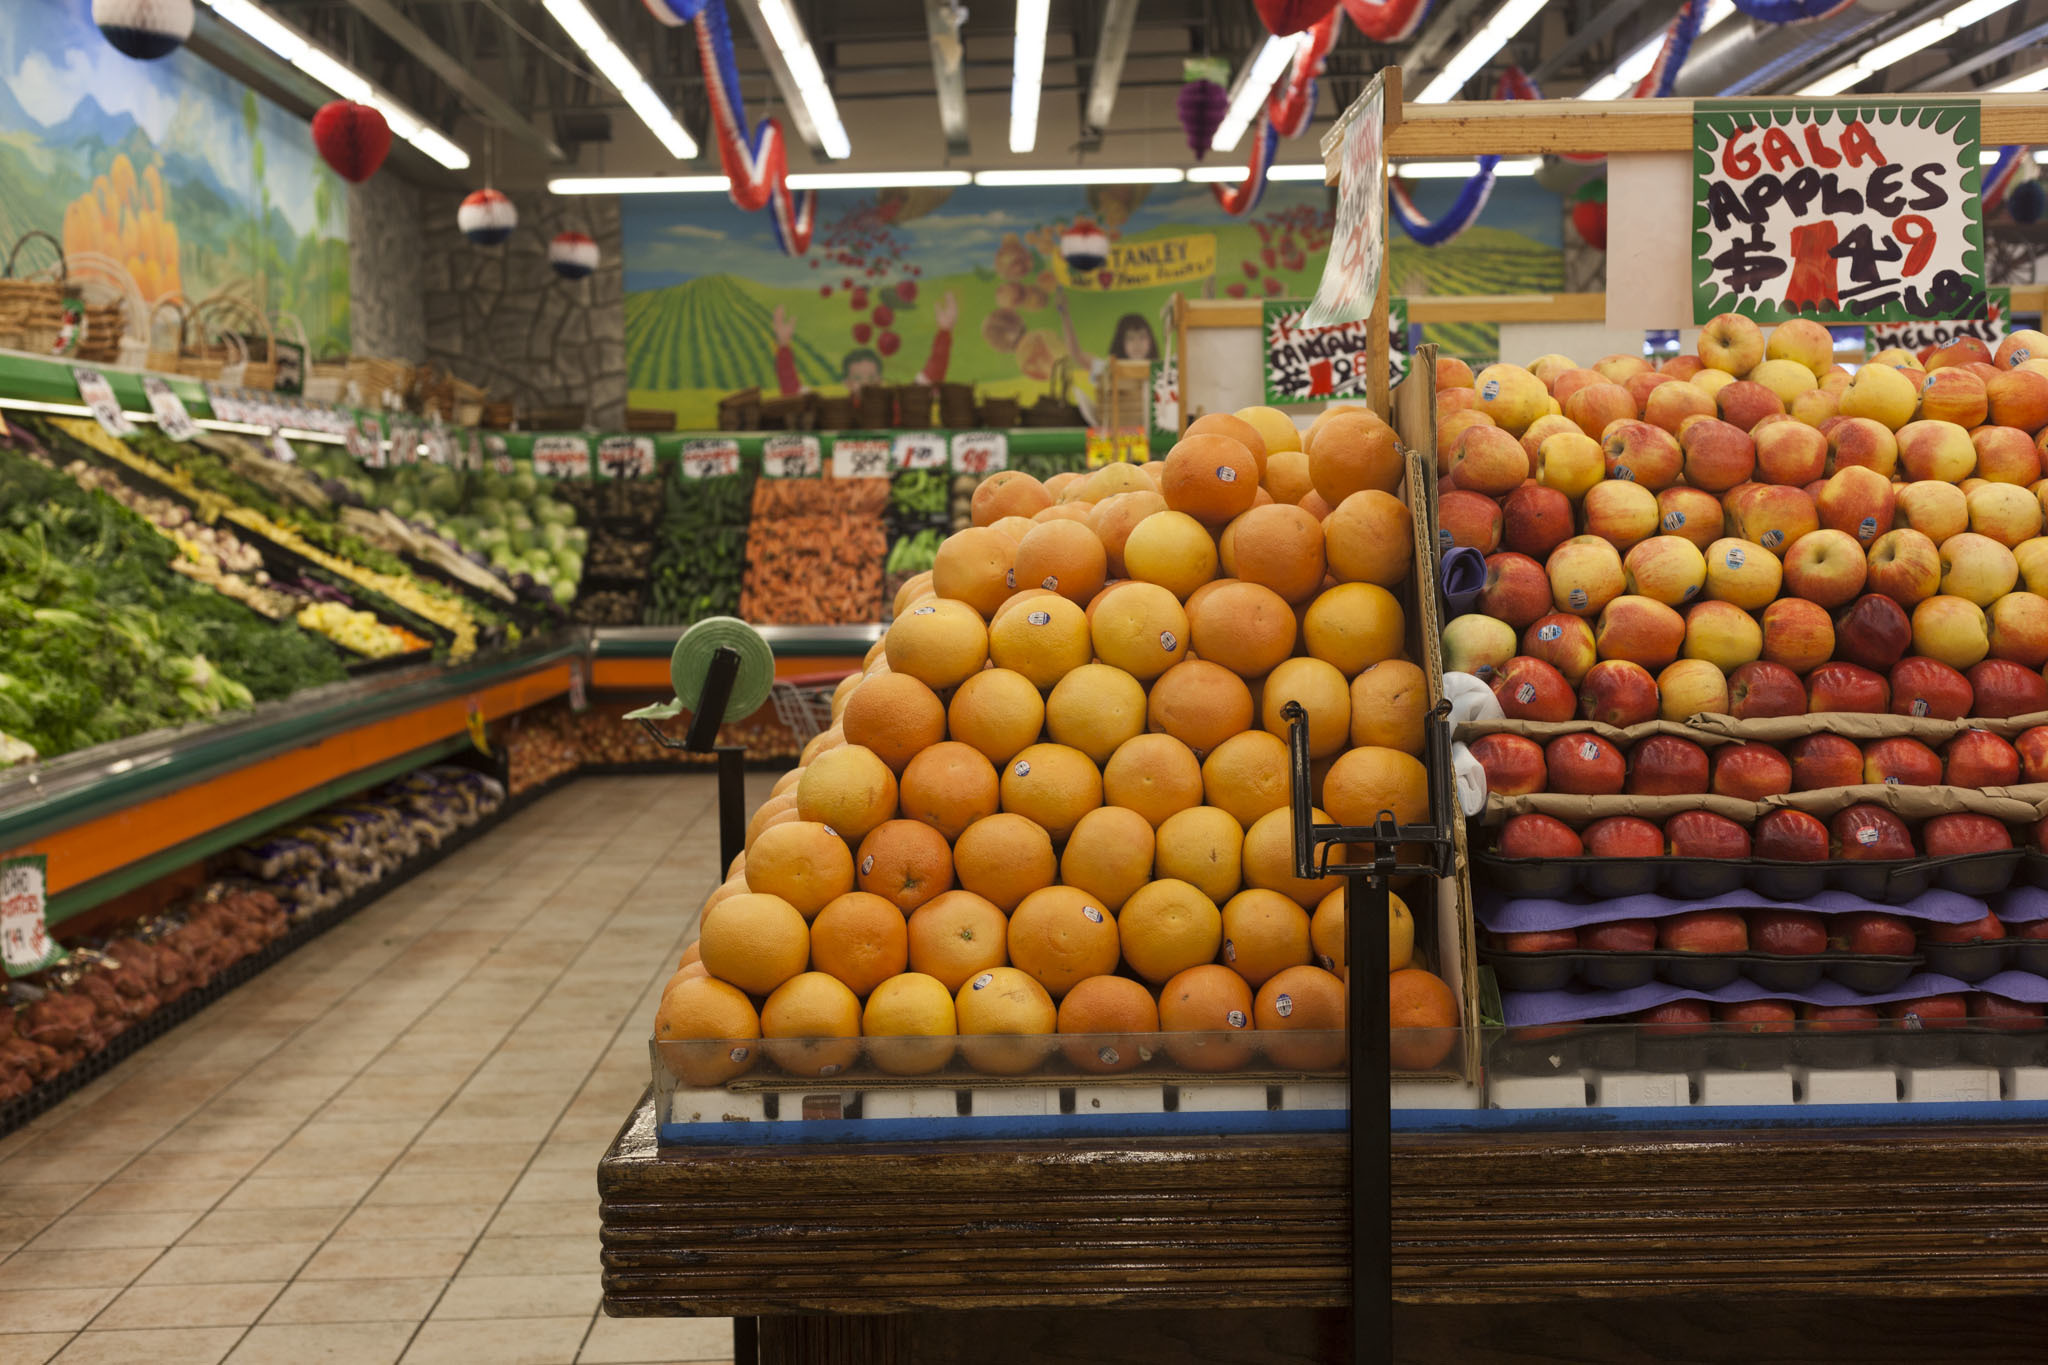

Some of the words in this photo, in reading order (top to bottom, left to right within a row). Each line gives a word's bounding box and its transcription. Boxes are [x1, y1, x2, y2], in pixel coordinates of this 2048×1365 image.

[1722, 120, 1887, 180] GALA
[1708, 163, 1949, 231] APPLES
[1111, 241, 1188, 267] TANLEY
